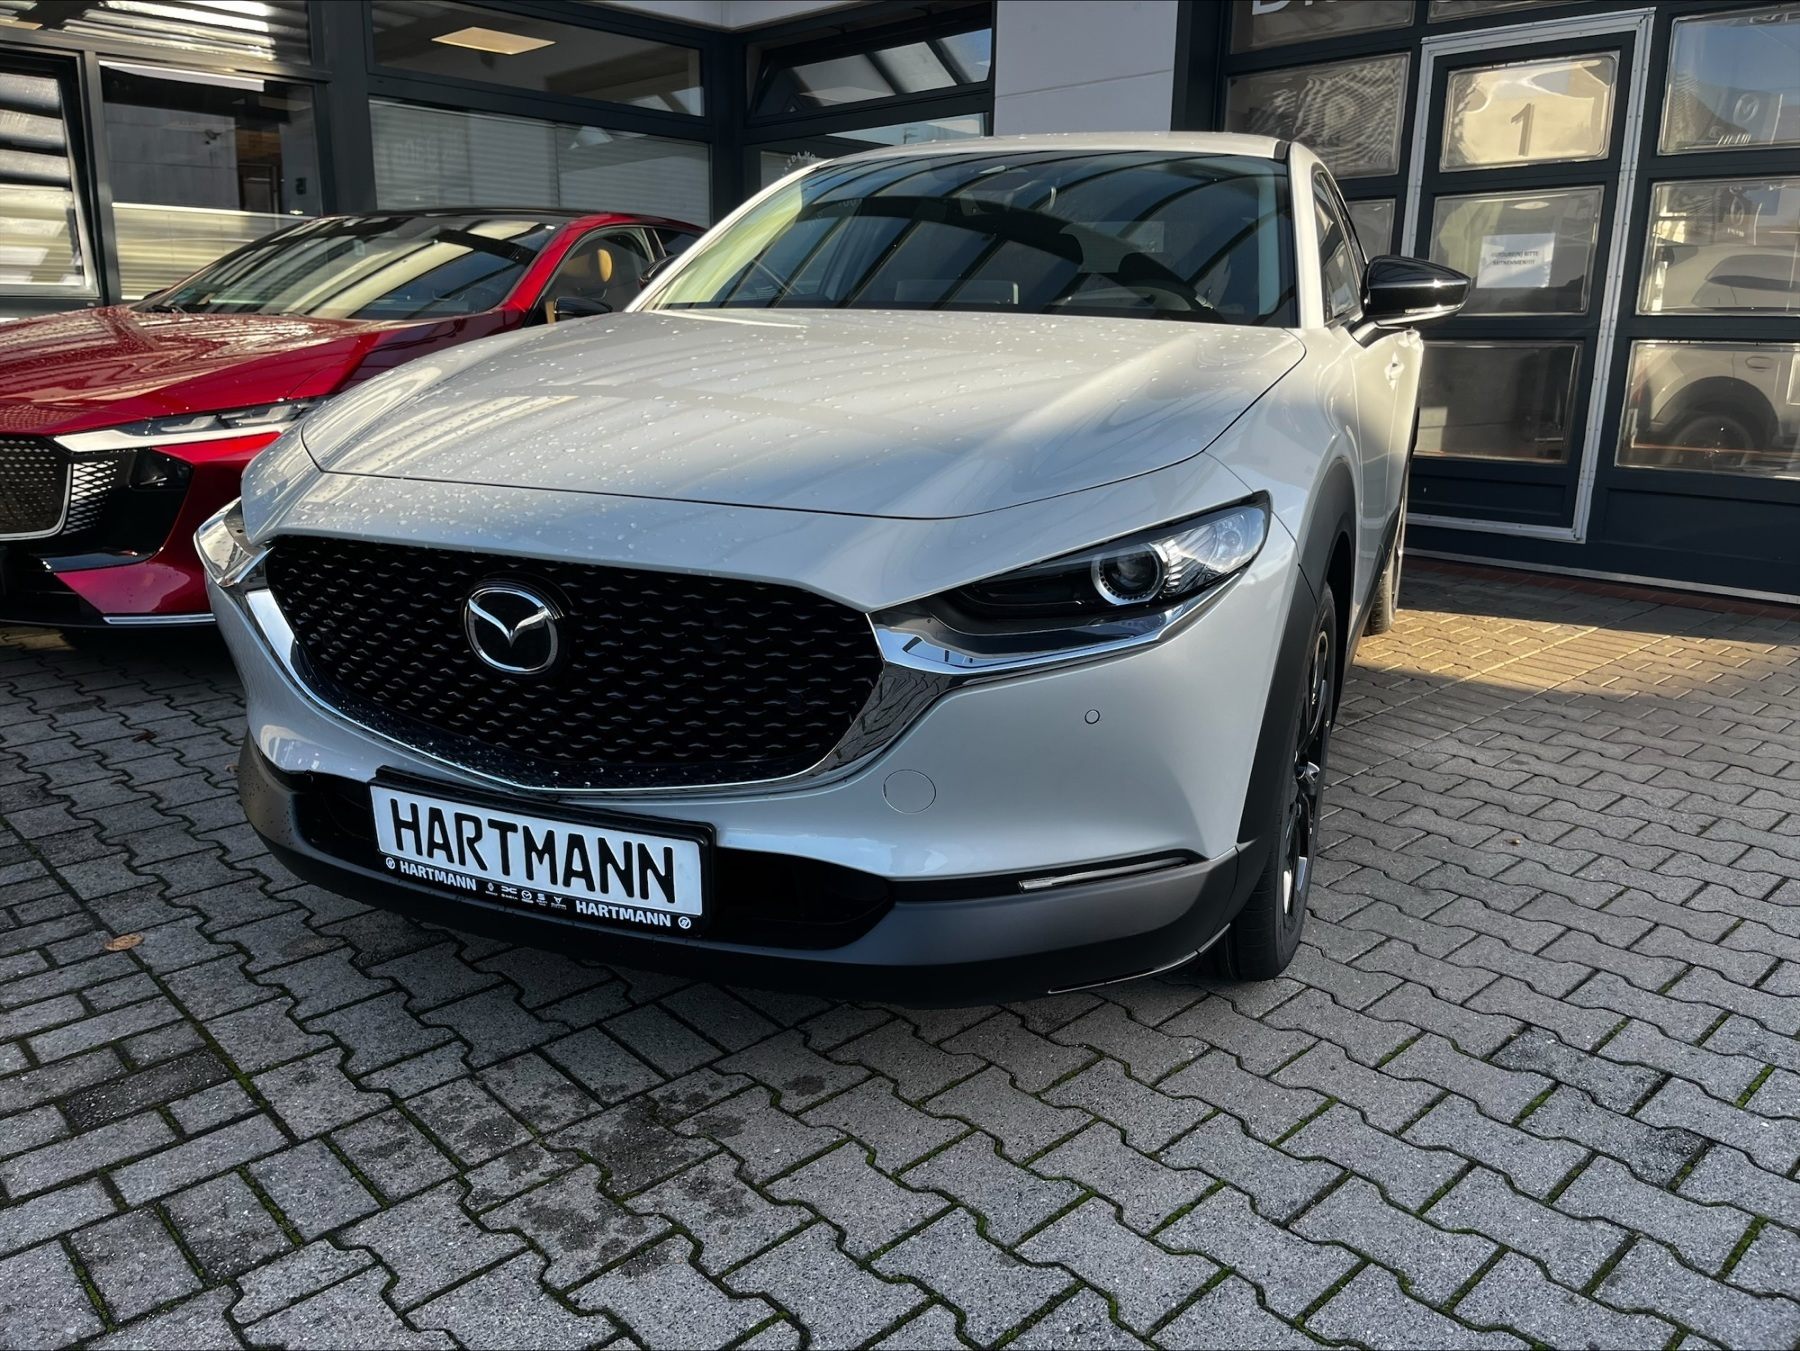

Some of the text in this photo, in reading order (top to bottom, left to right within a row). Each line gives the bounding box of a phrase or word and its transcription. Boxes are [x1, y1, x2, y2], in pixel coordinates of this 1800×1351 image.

[1511, 103, 1534, 156] 1
[390, 798, 676, 904] HARTMANN
[400, 860, 672, 927] HARTMANN HARTMANN
